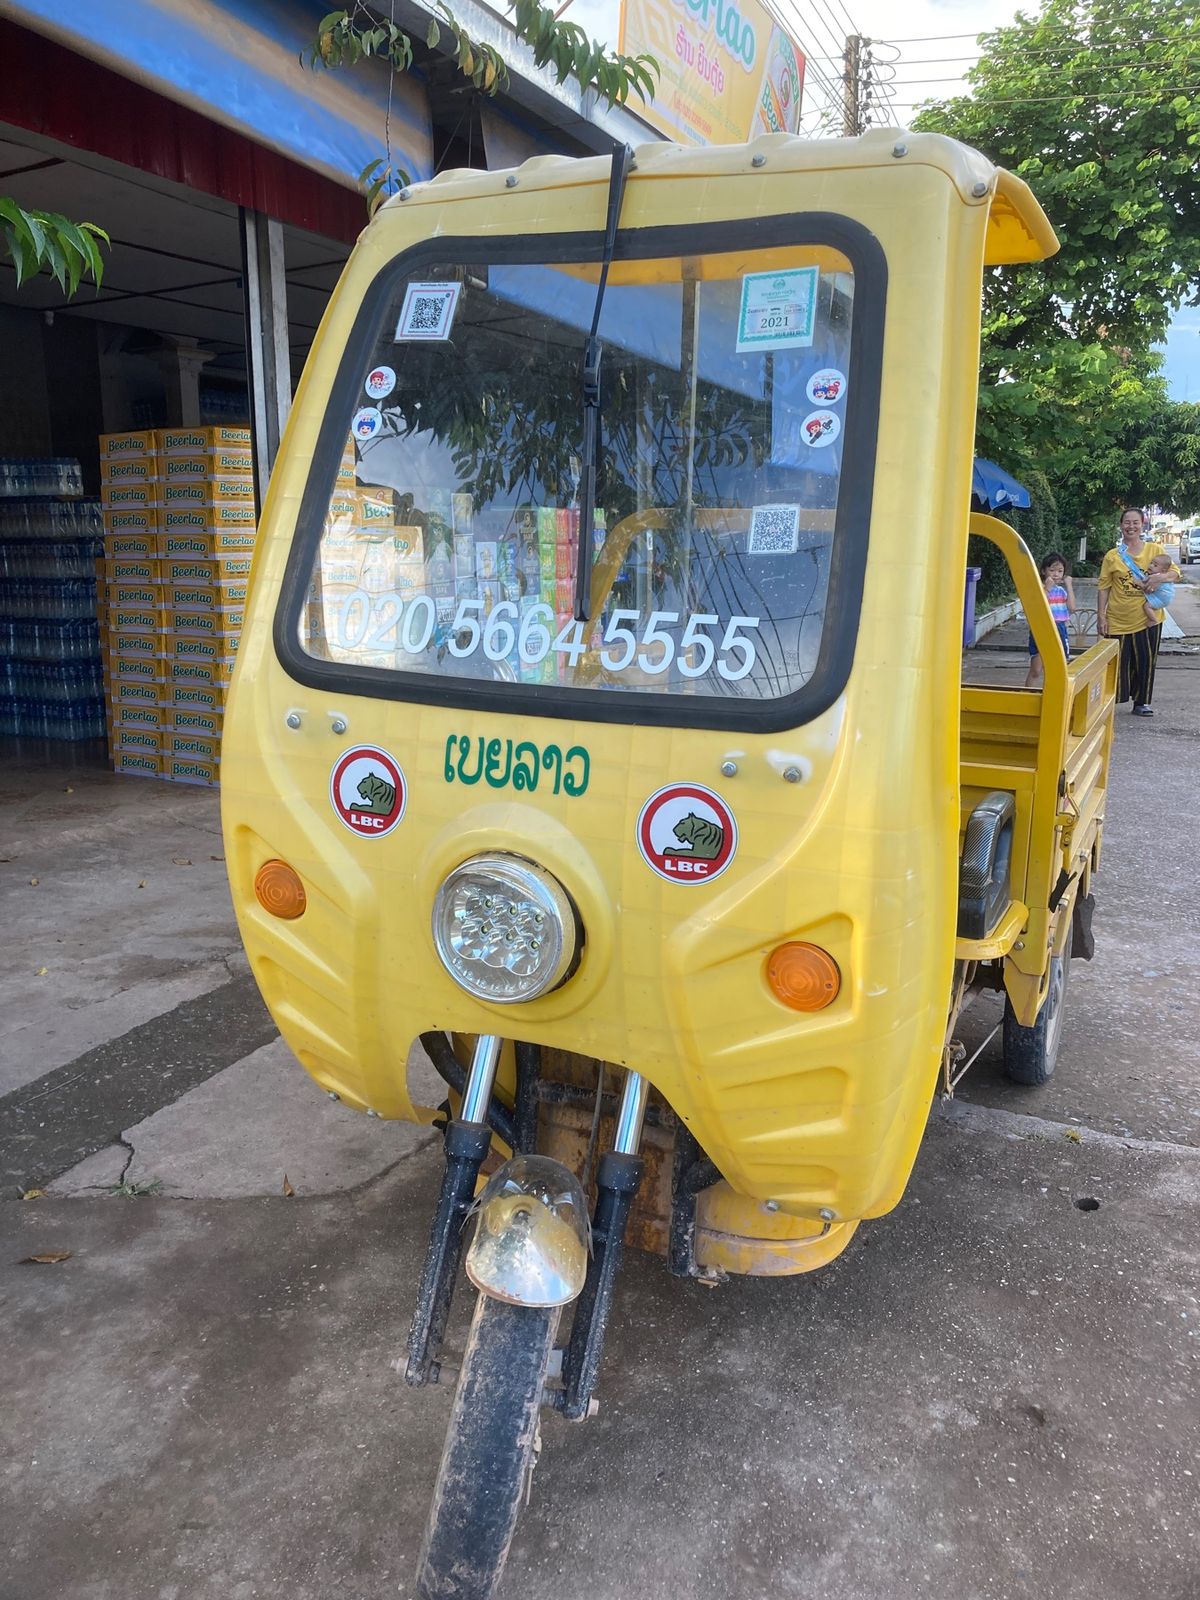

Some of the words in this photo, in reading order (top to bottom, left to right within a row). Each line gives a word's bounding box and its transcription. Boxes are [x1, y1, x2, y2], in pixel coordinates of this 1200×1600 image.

[760, 316, 789, 329] 2021
[109, 438, 144, 451] Beerlao
[166, 434, 205, 448] Beerlao
[110, 463, 146, 477] Beerlao
[167, 461, 205, 474] Beerlao
[166, 487, 204, 500] Beerlao
[219, 483, 253, 493] Beerlao
[110, 489, 146, 502] Beerlao
[166, 513, 204, 526] Beerlao
[221, 509, 255, 519] Beerlao
[112, 515, 147, 527] Beerlao
[113, 540, 147, 552] Beerlao
[167, 539, 206, 552] Beerlao
[222, 536, 255, 545] Beerlao
[115, 566, 150, 577] Beerlao
[172, 566, 211, 578] Beerlao
[118, 590, 153, 602] Beerlao
[174, 591, 212, 604] Beerlao
[117, 613, 154, 626] Beerlao
[175, 616, 213, 629] Beerlao
[337, 588, 435, 654] 020
[449, 599, 587, 668] 5664
[600, 608, 760, 681] 5555
[118, 638, 153, 651] Beerlao
[176, 641, 215, 656] Beerlao
[118, 662, 153, 675] Beerlao
[173, 665, 211, 679] Beerlao
[120, 686, 156, 699] Beerlao
[174, 689, 213, 704] Beerlao
[121, 709, 158, 723] Beerlao
[175, 714, 214, 729] Beerlao
[121, 733, 157, 747] Beerlao
[173, 739, 212, 754] Beerlao
[121, 755, 157, 770] Beerlao
[443, 733, 591, 797] ເບຍລາວ
[173, 763, 210, 779] Beerlao
[350, 813, 384, 829] LBC
[664, 858, 708, 875] LBC
